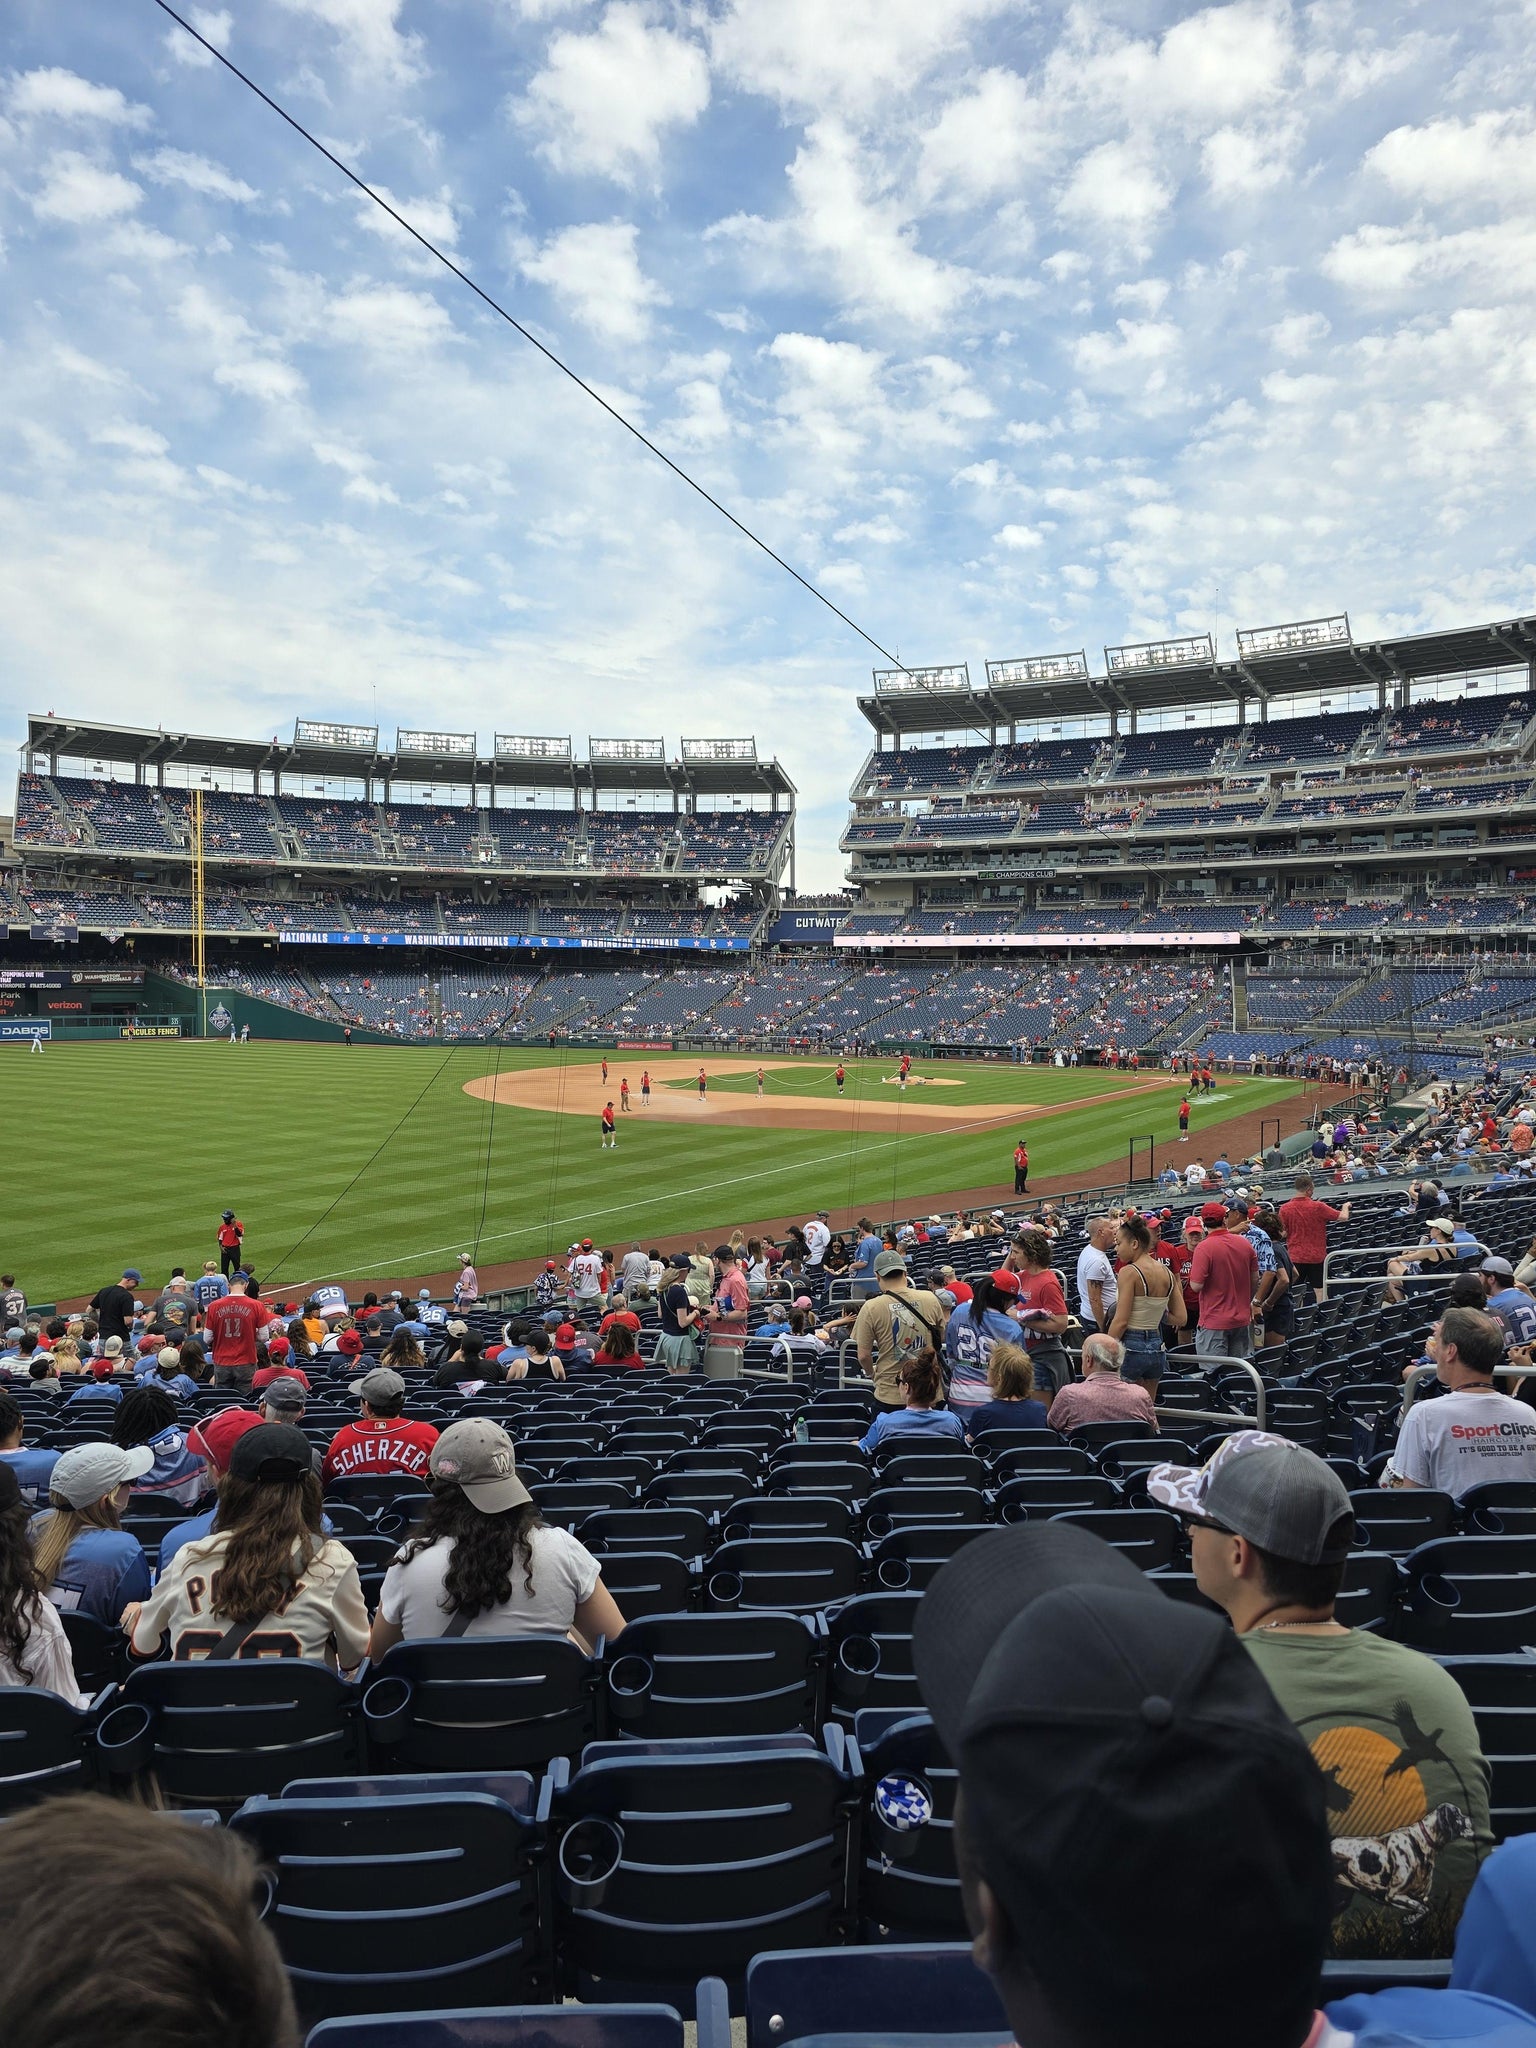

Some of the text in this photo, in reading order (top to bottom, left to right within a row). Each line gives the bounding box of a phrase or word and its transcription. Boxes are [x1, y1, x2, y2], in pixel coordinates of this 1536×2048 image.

[280, 932, 328, 943] NATIONALS
[405, 935, 509, 946] WASHINGTON NATIONALS
[581, 938, 680, 948] WASHINGTON NATIONALS
[1, 991, 21, 999] Park
[4, 999, 15, 1008] by
[122, 1027, 179, 1036] HCULES FENCE
[1341, 1174, 1354, 1183] 29
[808, 1231, 814, 1245] 2
[578, 1263, 592, 1275] 24
[201, 1286, 218, 1299] 26
[317, 1287, 340, 1301] 26
[6, 1299, 25, 1316] 37
[215, 1304, 252, 1319] ZIMMERMAN
[423, 1309, 442, 1321] 26
[574, 1338, 587, 1347] SOTO
[1451, 1422, 1536, 1440] SportClips
[1459, 1446, 1476, 1454] IT'S
[1477, 1444, 1496, 1452] GOOD
[332, 1438, 428, 1476] SCHERZER
[492, 1451, 511, 1475] W
